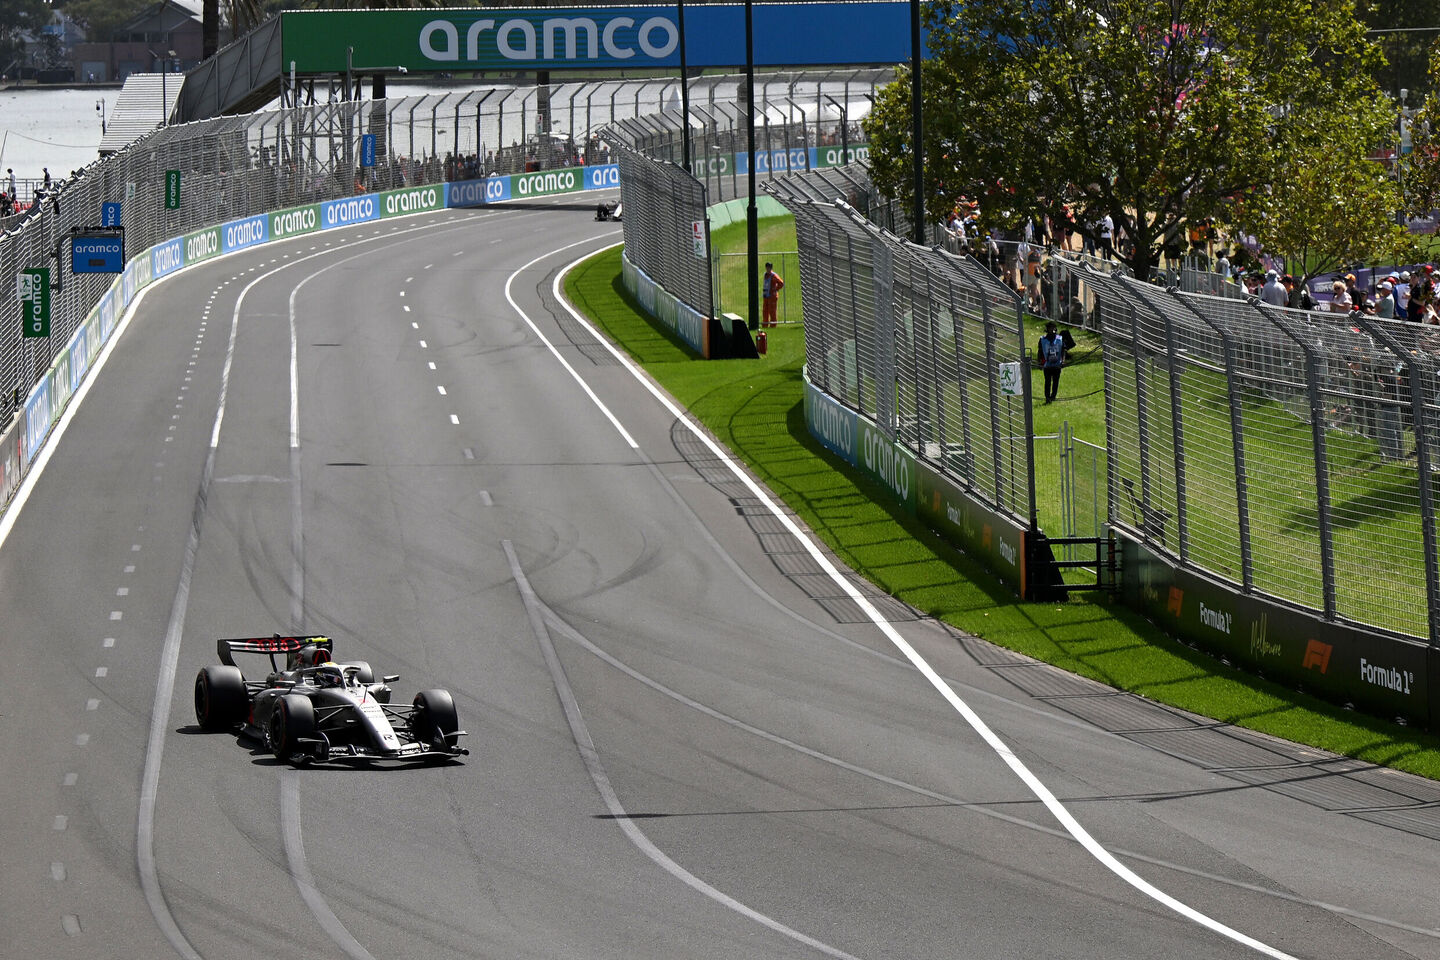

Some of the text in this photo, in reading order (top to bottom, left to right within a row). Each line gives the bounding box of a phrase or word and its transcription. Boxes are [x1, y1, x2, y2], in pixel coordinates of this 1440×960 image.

[419, 16, 679, 61] aramco
[747, 151, 806, 170] ramco
[518, 172, 575, 195] aramco
[592, 167, 619, 186] ara
[386, 189, 436, 214] aramco
[451, 180, 503, 203] aramco
[274, 208, 316, 236] aramco
[327, 198, 373, 225] aramco
[187, 230, 218, 260] aramco
[227, 219, 263, 248] aramco
[75, 244, 120, 253] aramco
[155, 243, 181, 274] aramco
[33, 273, 42, 333] aramco
[813, 396, 851, 456] aramco
[864, 428, 909, 501] aramco
[1200, 602, 1225, 632] Formula
[1361, 658, 1402, 692] Formula
